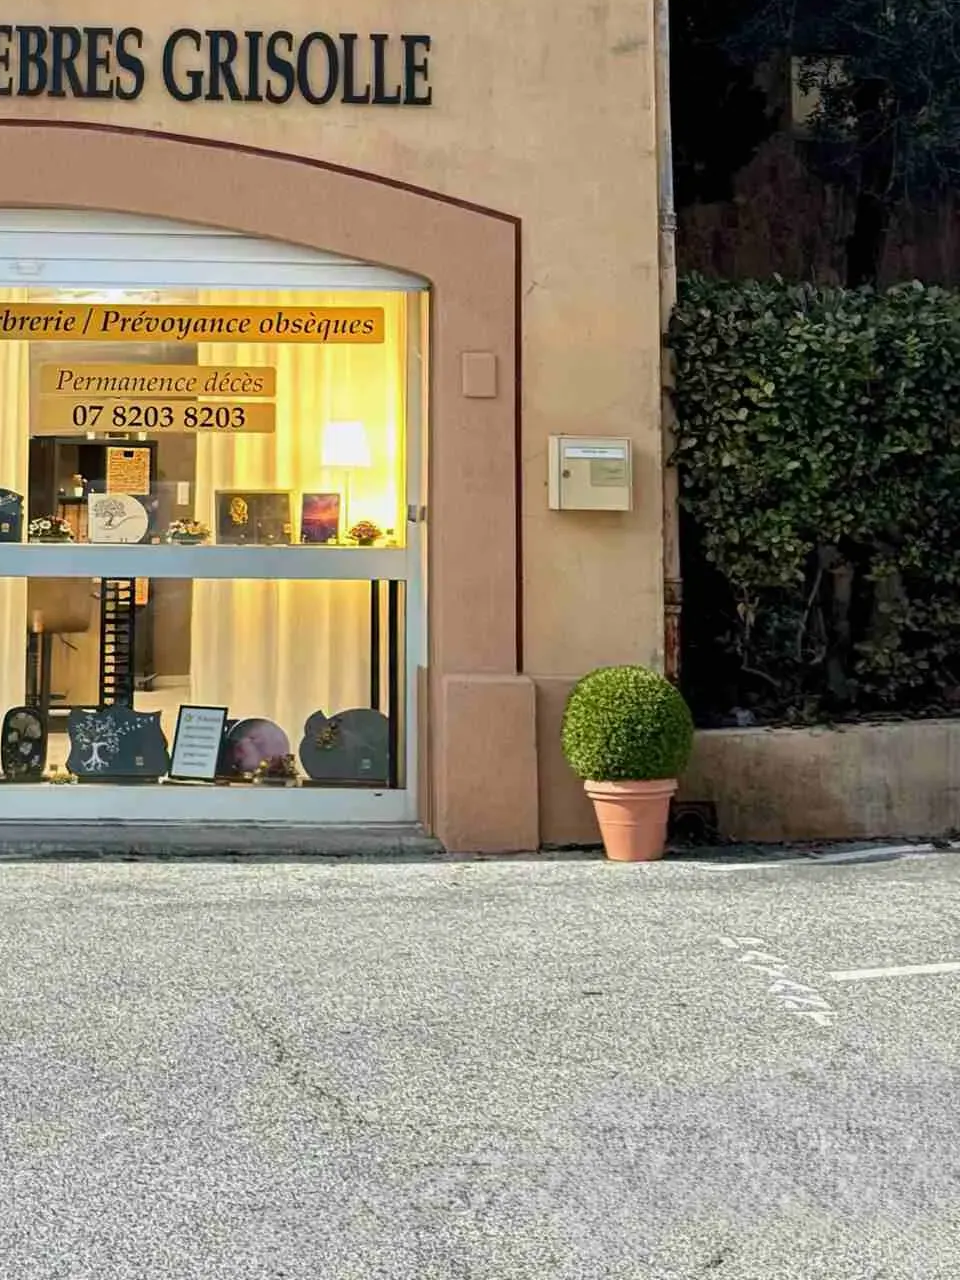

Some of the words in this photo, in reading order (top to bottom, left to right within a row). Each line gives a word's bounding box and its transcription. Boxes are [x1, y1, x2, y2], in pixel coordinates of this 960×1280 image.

[163, 27, 433, 106] GRISOLLE
[82, 307, 94, 335] /
[101, 309, 251, 340] Prévoyance
[258, 311, 375, 341] obsèques
[55, 369, 195, 393] Permanence
[204, 371, 264, 393] décès
[72, 405, 104, 427] 07
[112, 405, 174, 428] 8203
[183, 406, 246, 428] 8203
